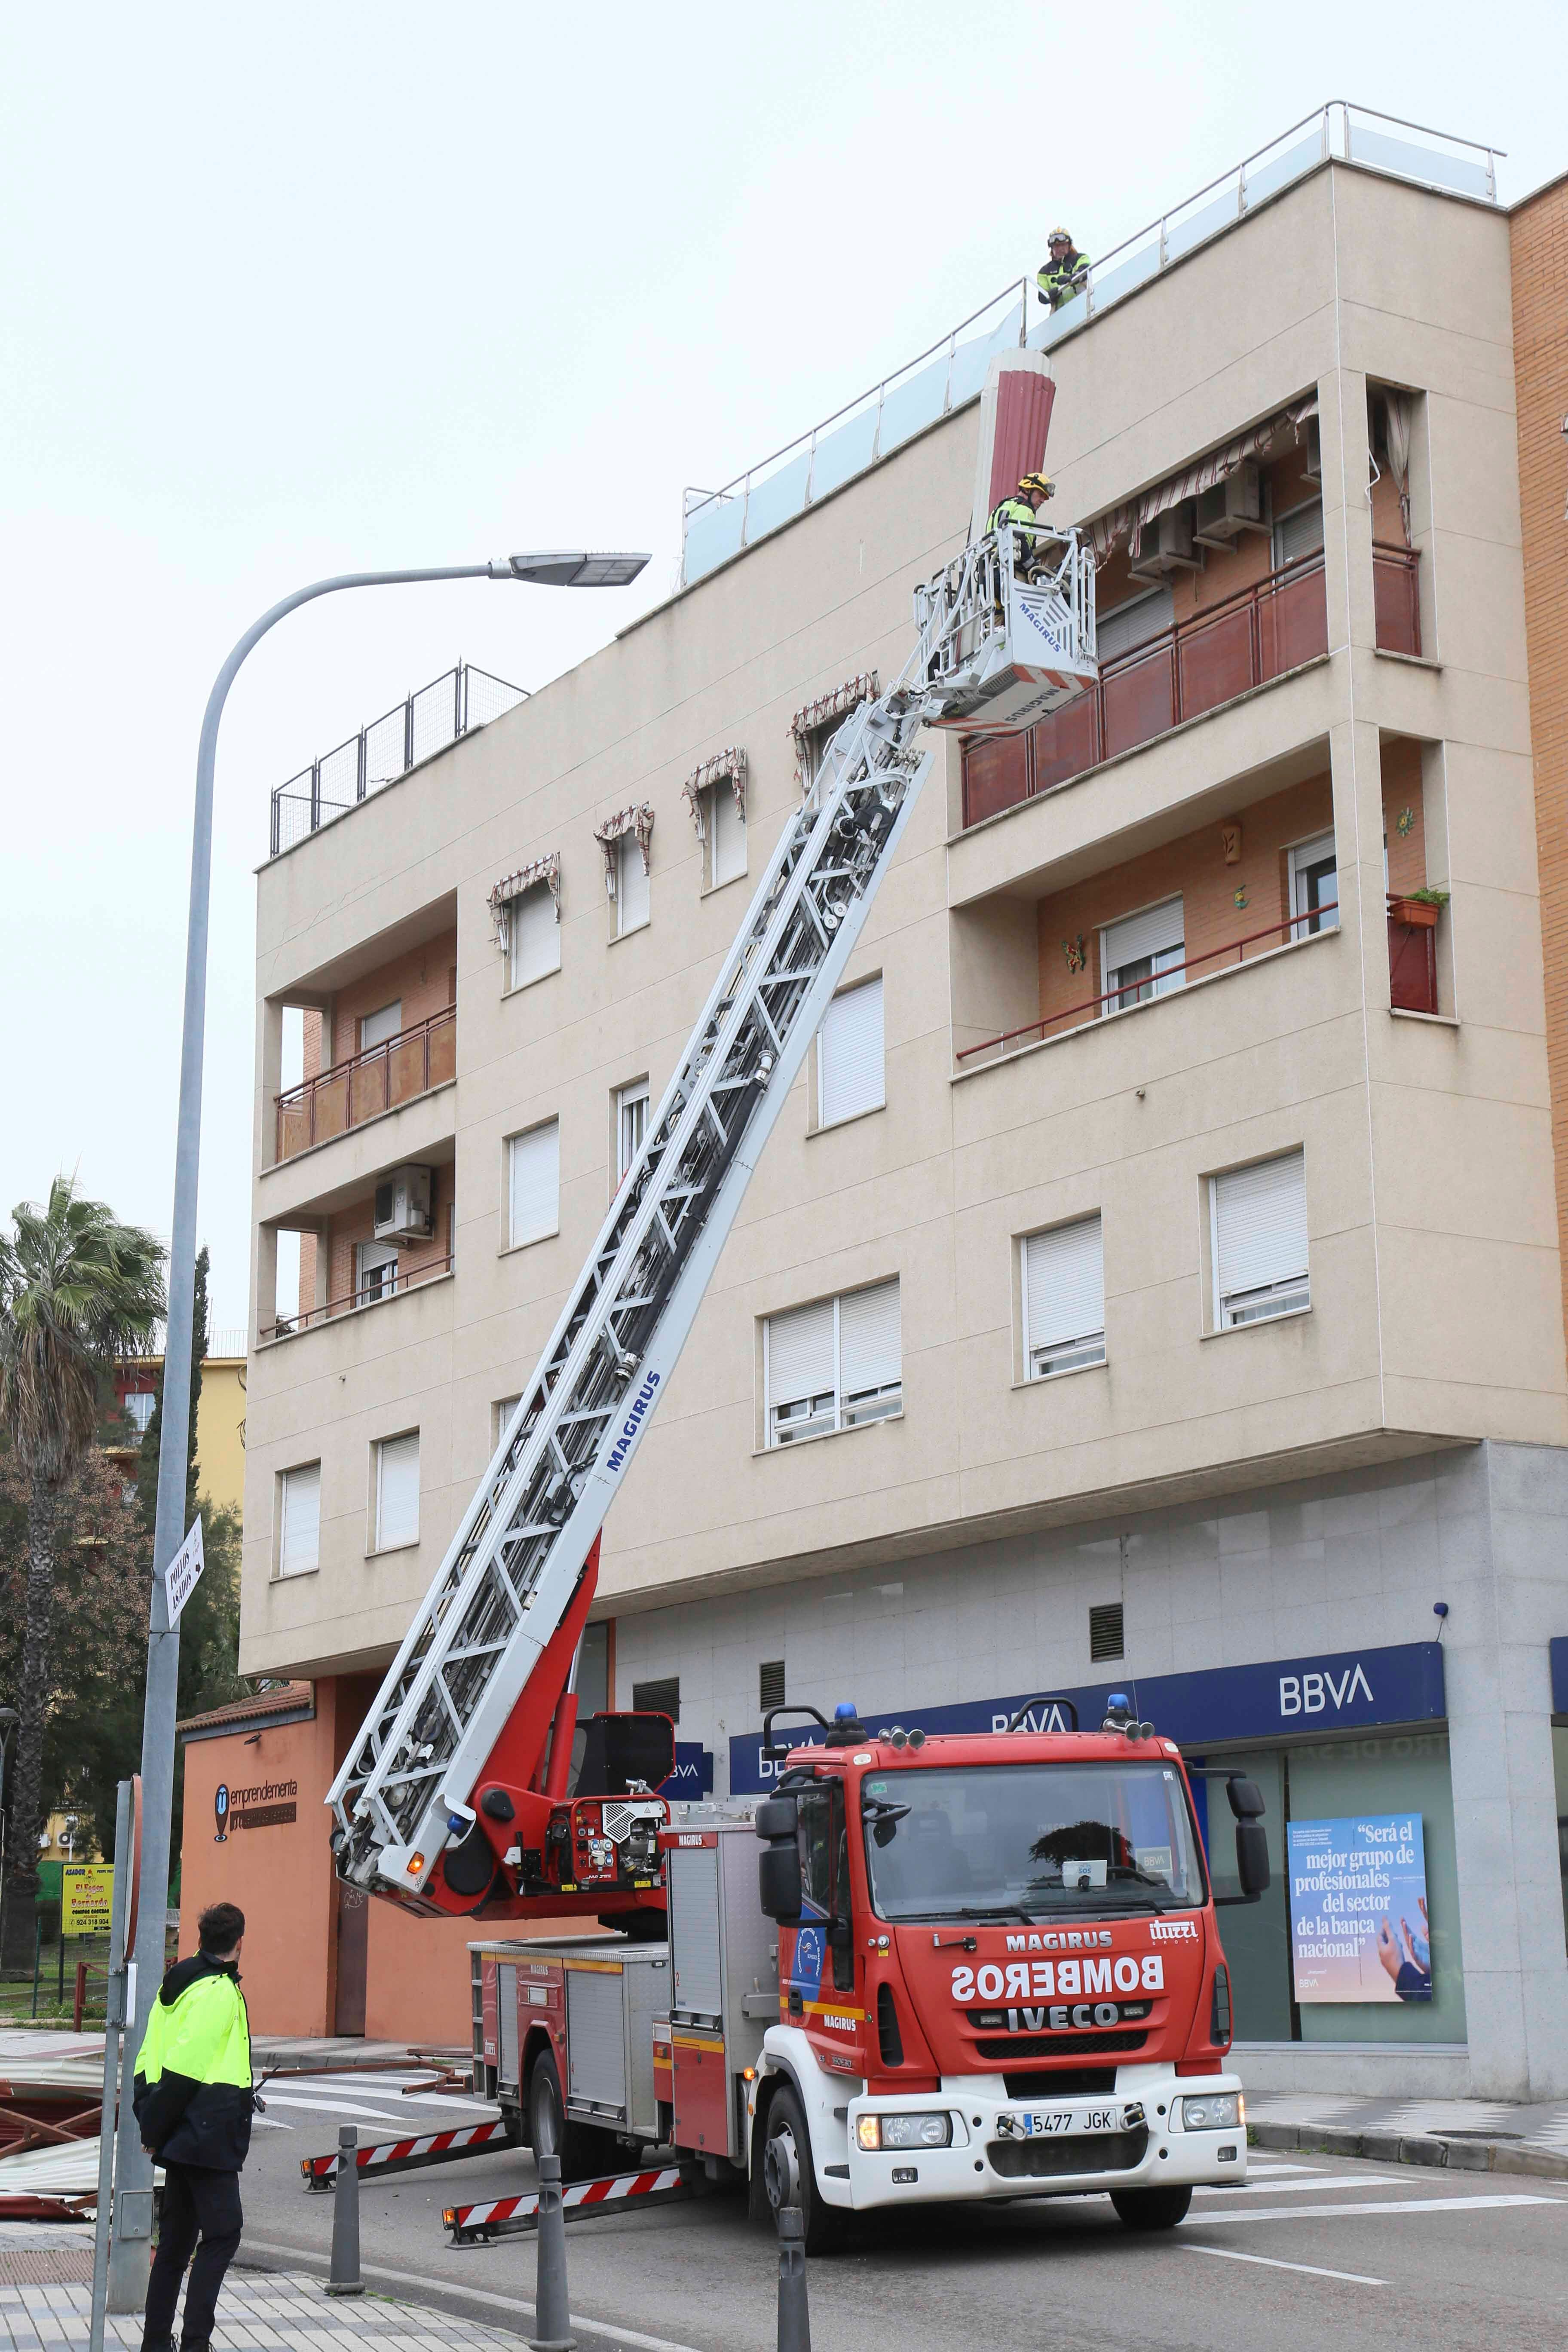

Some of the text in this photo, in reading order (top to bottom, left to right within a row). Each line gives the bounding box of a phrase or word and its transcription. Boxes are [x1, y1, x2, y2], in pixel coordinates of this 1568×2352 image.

[1019, 603, 1061, 652] MAGIRUS
[1005, 689, 1060, 722] MAGIRUS
[606, 1371, 660, 1472] MAGIRUS
[170, 1547, 189, 1590] POLLOS
[172, 1569, 192, 1613] ASADOS
[1280, 1663, 1373, 1716] BBVA
[670, 1764, 698, 1778] BVA
[679, 1834, 702, 1846] MAGIRUS
[1400, 1821, 1413, 1841] el
[1144, 1855, 1165, 1866] BBVA
[1306, 1844, 1414, 1872] mejor grupo de
[76, 1884, 83, 1893] El
[415, 1875, 424, 1888] 30m
[1295, 1868, 1390, 1896] profesionales
[71, 1898, 107, 1908] Bernardo
[1323, 1893, 1390, 1913] del sector
[1149, 1920, 1198, 1940] iturri
[1297, 1915, 1375, 1936] de la banca
[1006, 1931, 1113, 1952] MAGIRUS
[530, 1964, 548, 1975] MAGIRUS
[676, 1972, 680, 1987] 2
[1299, 1978, 1319, 1988] BBVA
[824, 2015, 856, 2031] MAGIRUS
[1008, 2003, 1119, 2033] IVECO
[1033, 2114, 1072, 2132] 5477
[1084, 2112, 1111, 2129] JGK
